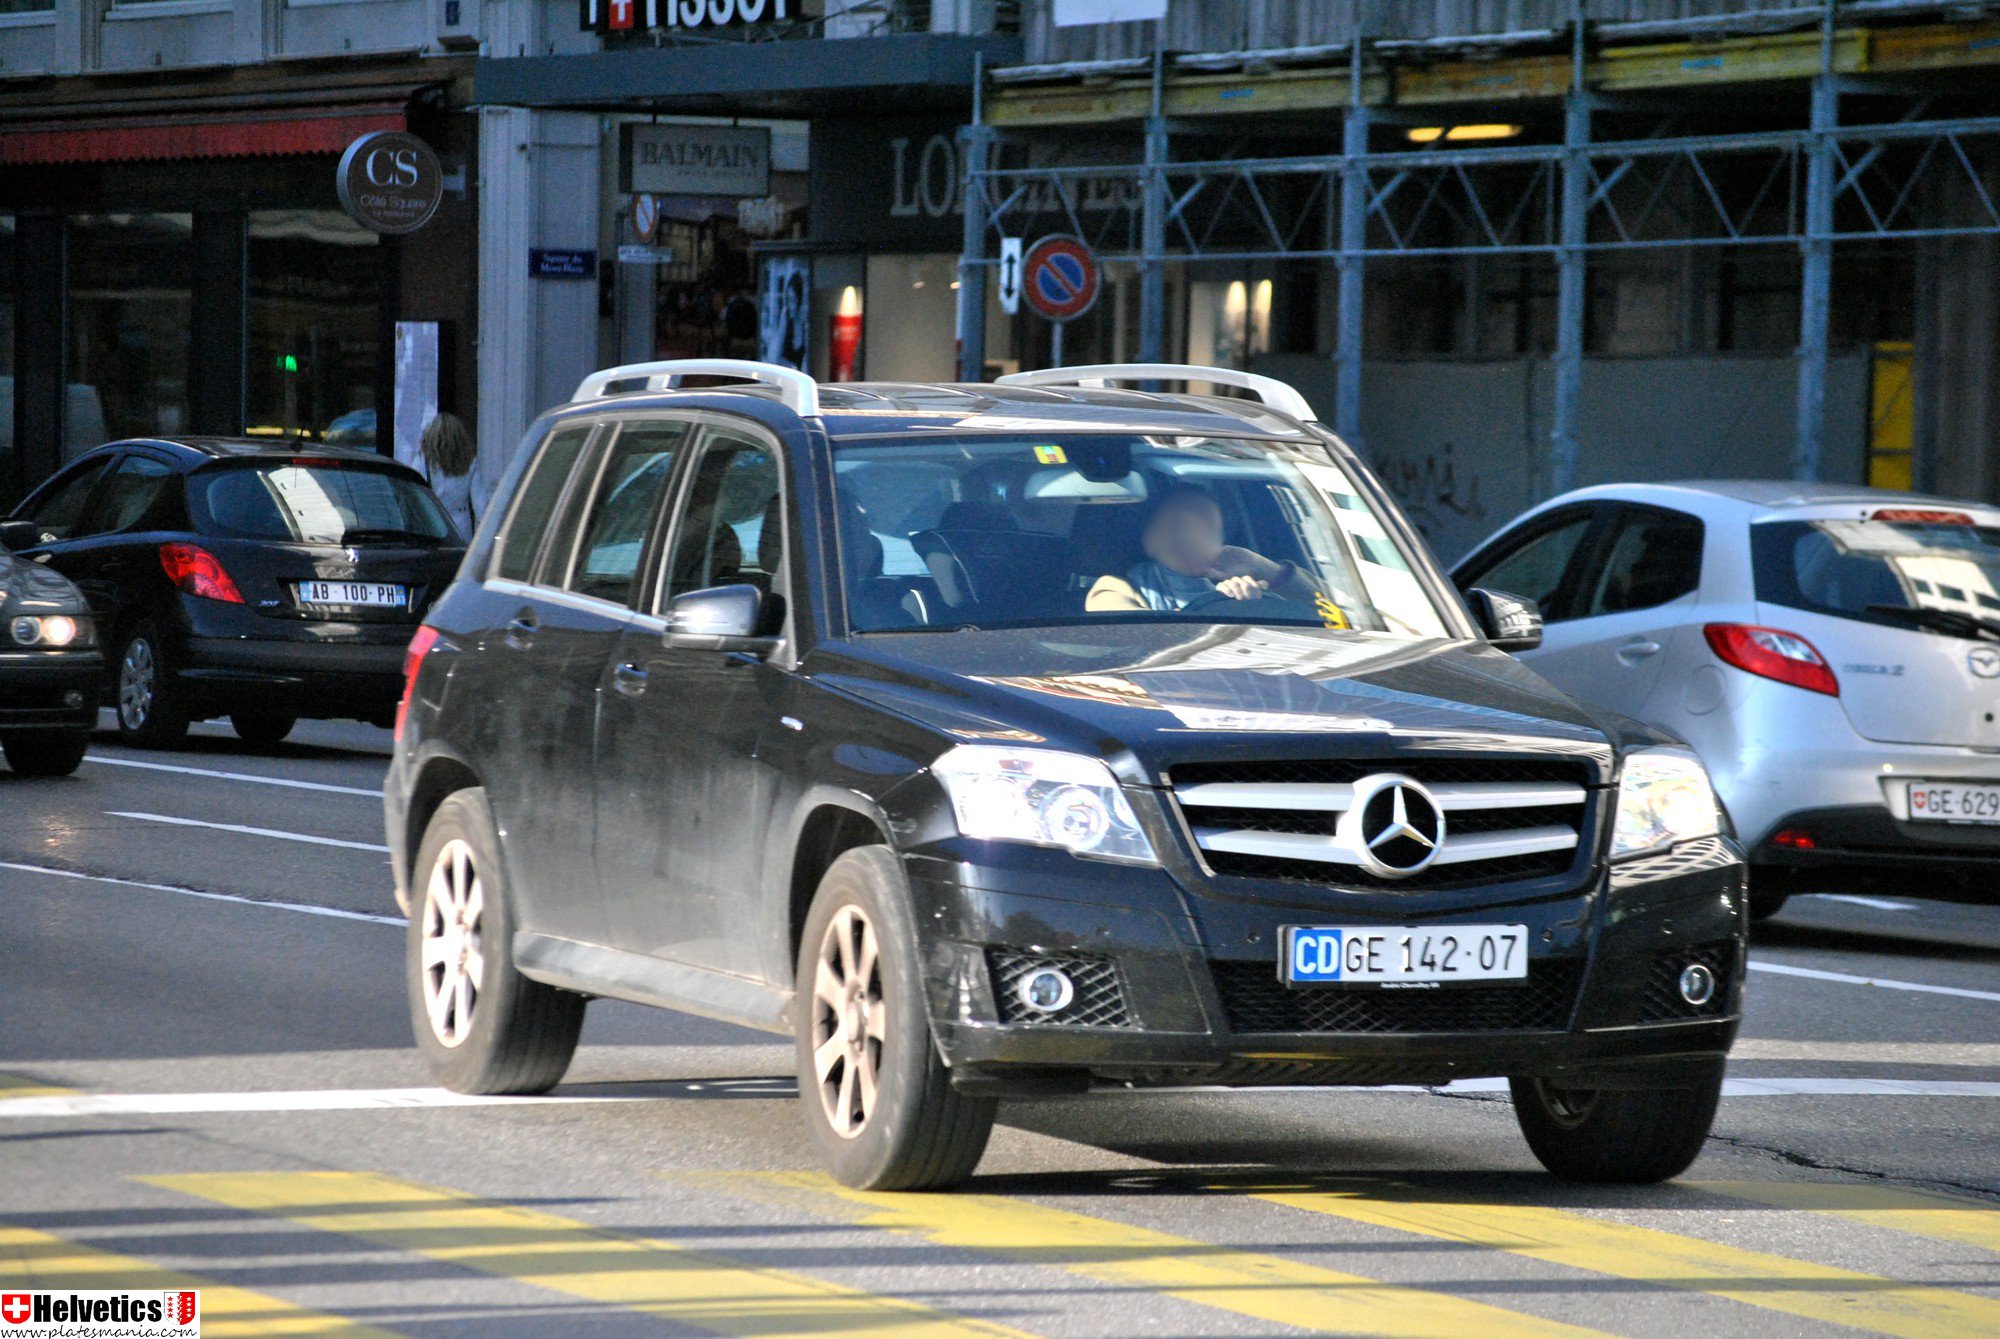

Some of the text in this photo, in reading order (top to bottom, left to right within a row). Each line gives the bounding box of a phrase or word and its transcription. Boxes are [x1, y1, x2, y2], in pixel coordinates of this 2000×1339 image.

[366, 149, 418, 187] CS
[641, 141, 758, 168] BALMAIN
[1295, 935, 1340, 975] CD
[1346, 936, 1386, 973] GE
